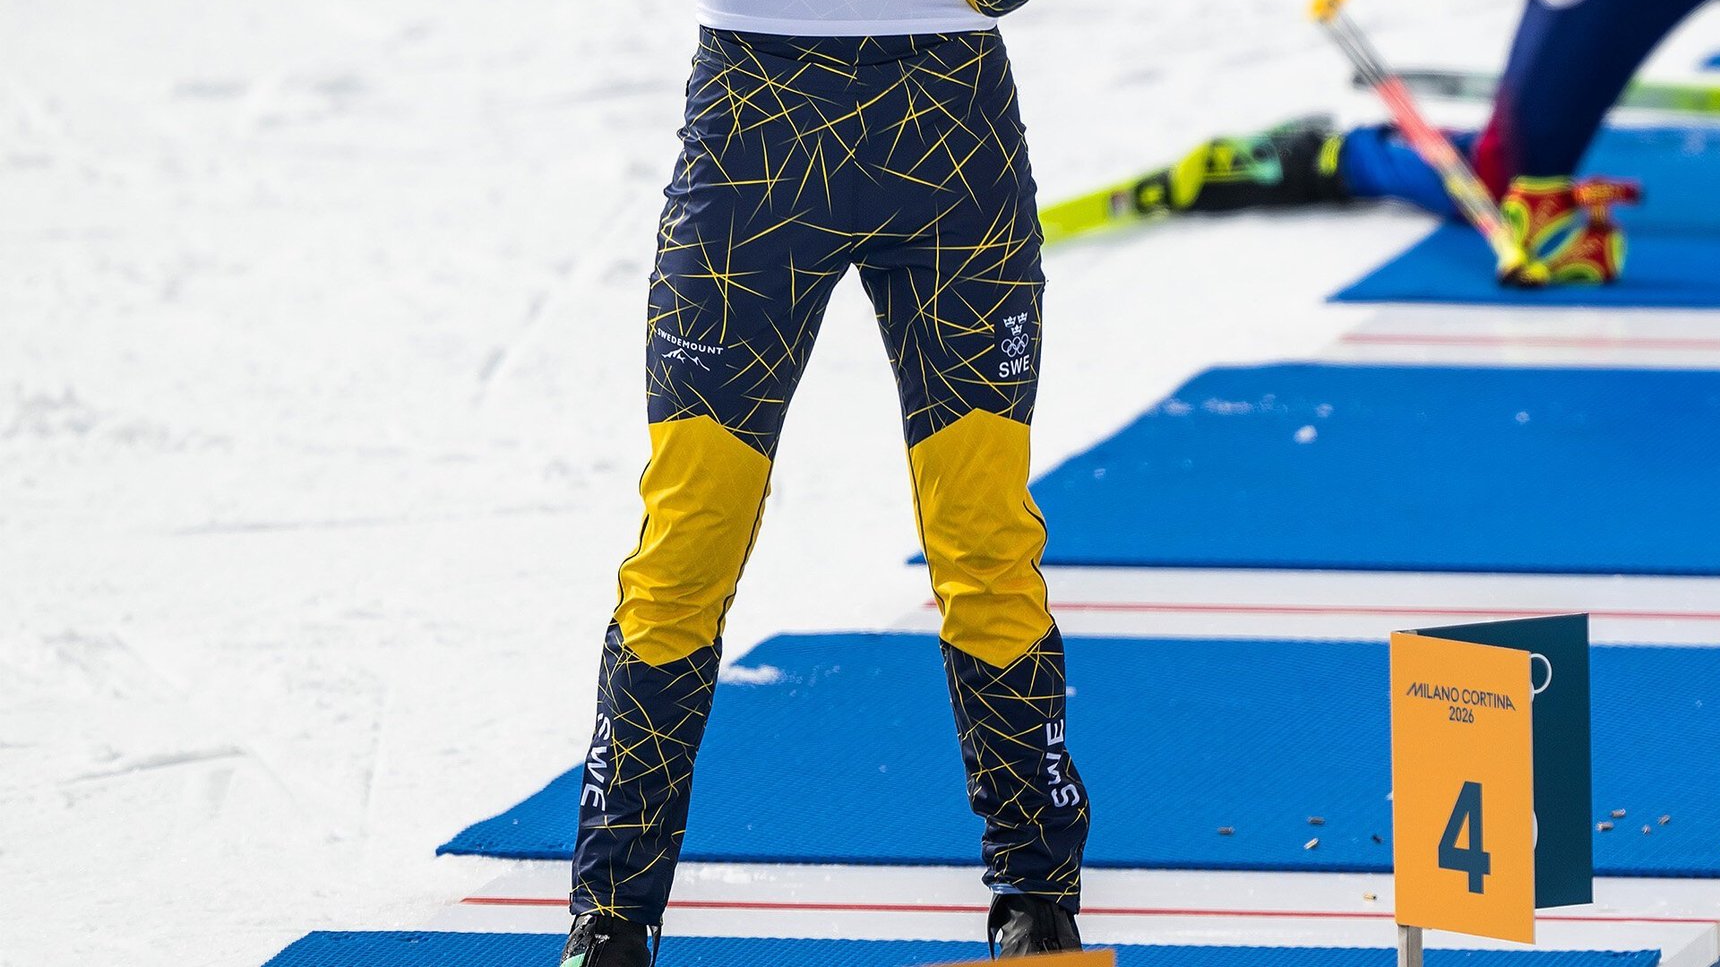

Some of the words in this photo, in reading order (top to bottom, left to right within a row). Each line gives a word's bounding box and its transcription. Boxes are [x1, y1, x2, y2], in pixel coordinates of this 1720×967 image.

[657, 327, 724, 355] SWEDEMOUNT
[998, 354, 1030, 378] SWE
[1406, 682, 1460, 703] MILANO
[1462, 689, 1517, 712] CORTINA
[1448, 706, 1475, 724] 2026
[580, 712, 611, 812] SWE
[1045, 719, 1081, 808] SWE
[1438, 781, 1492, 894] 4
